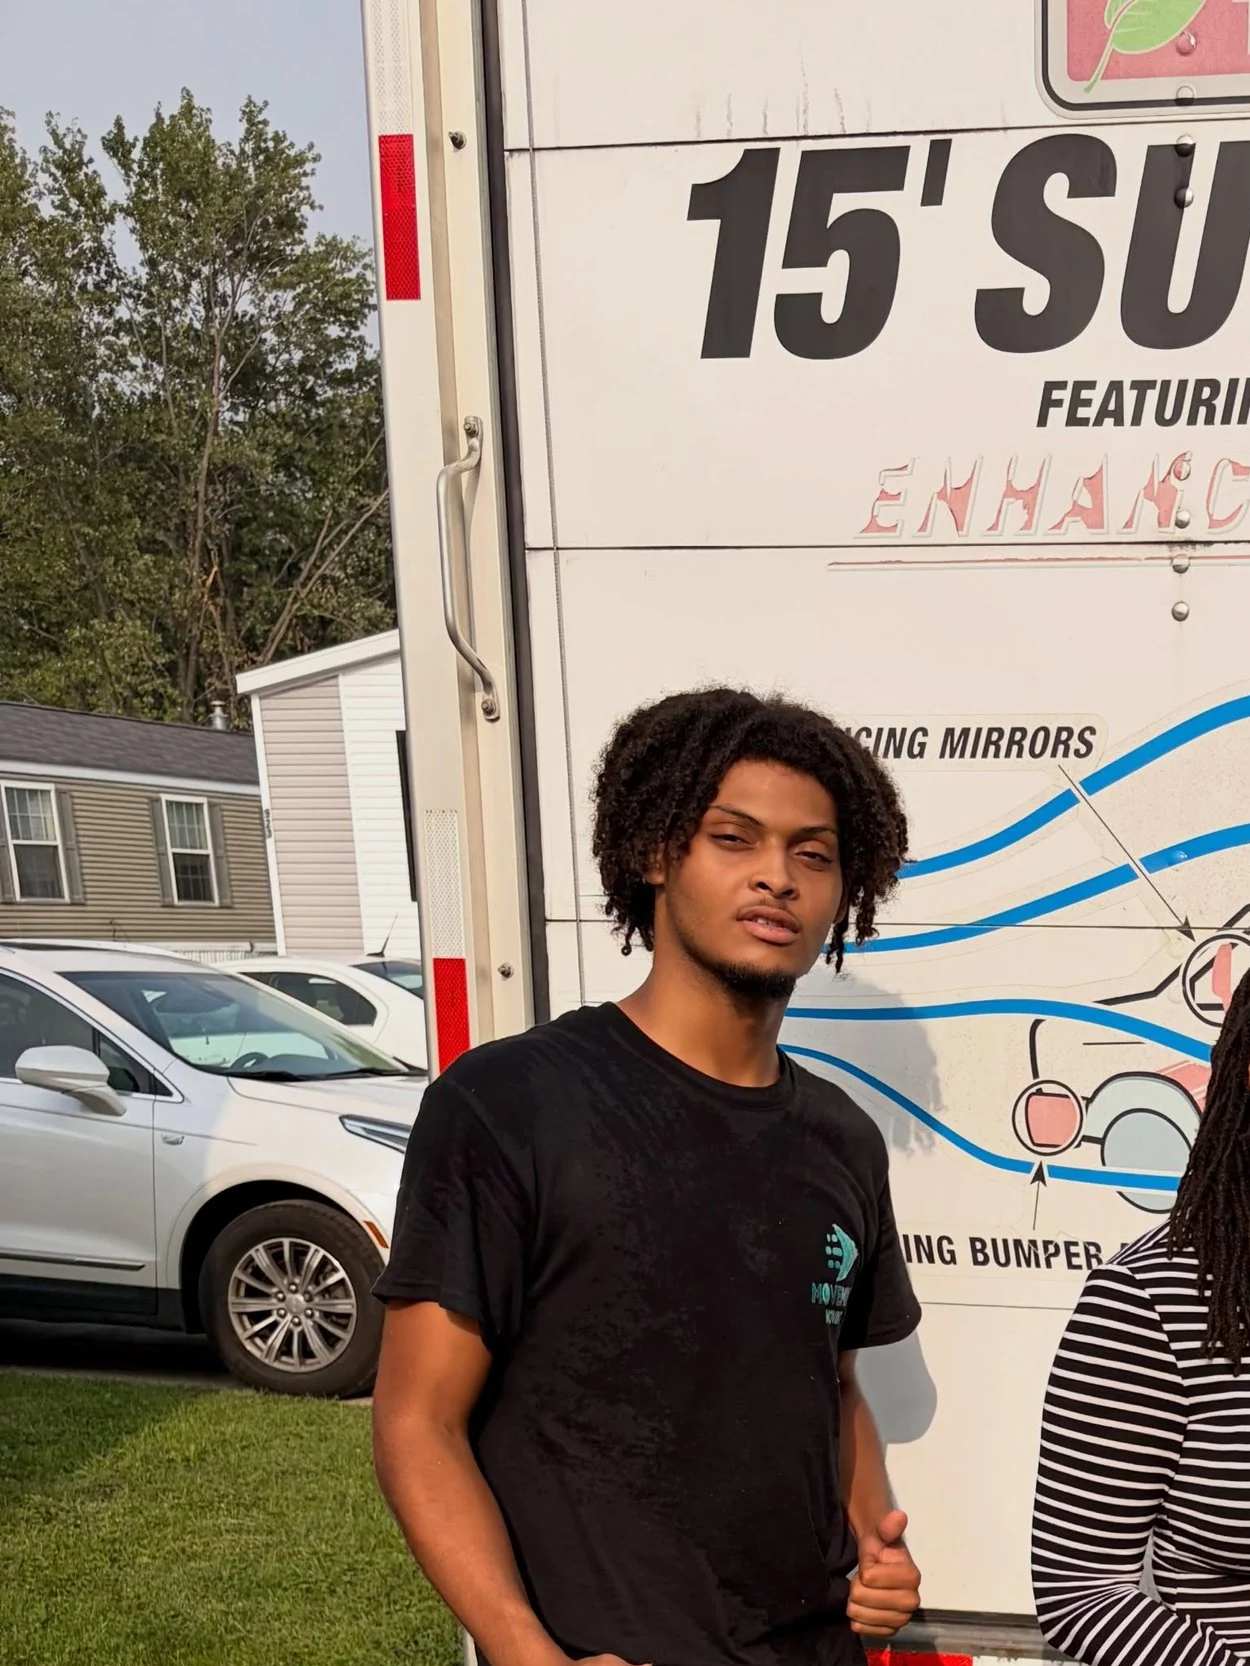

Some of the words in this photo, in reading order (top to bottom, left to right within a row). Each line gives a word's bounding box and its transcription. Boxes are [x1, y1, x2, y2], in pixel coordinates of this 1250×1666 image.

[687, 138, 952, 360] 15'
[938, 725, 1097, 760] MIRRORS
[902, 1234, 957, 1265] ING
[969, 1236, 1103, 1271] BUMPER
[811, 1282, 851, 1307] MOVEM
